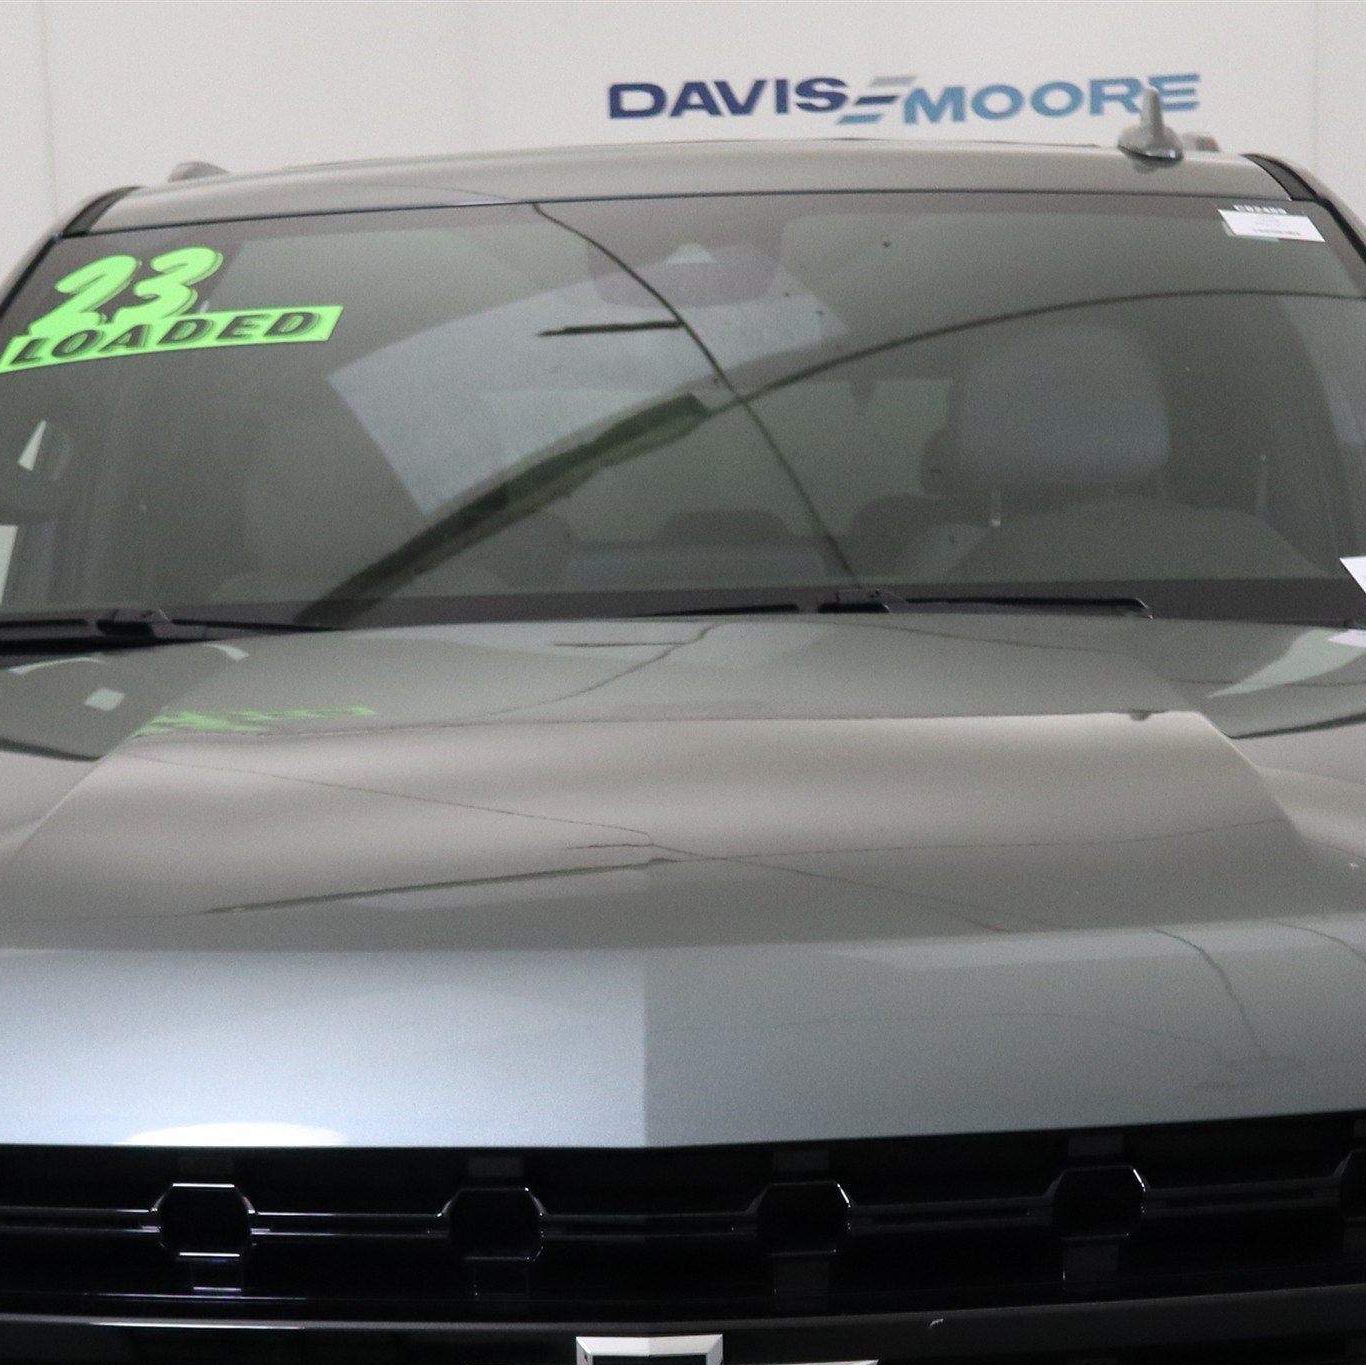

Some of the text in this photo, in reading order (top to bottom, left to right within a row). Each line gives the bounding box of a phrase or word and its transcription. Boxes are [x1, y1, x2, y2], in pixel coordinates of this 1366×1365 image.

[609, 74, 1201, 124] DAVIS MOORE
[28, 246, 224, 336] 23
[9, 311, 321, 365] LOADED
